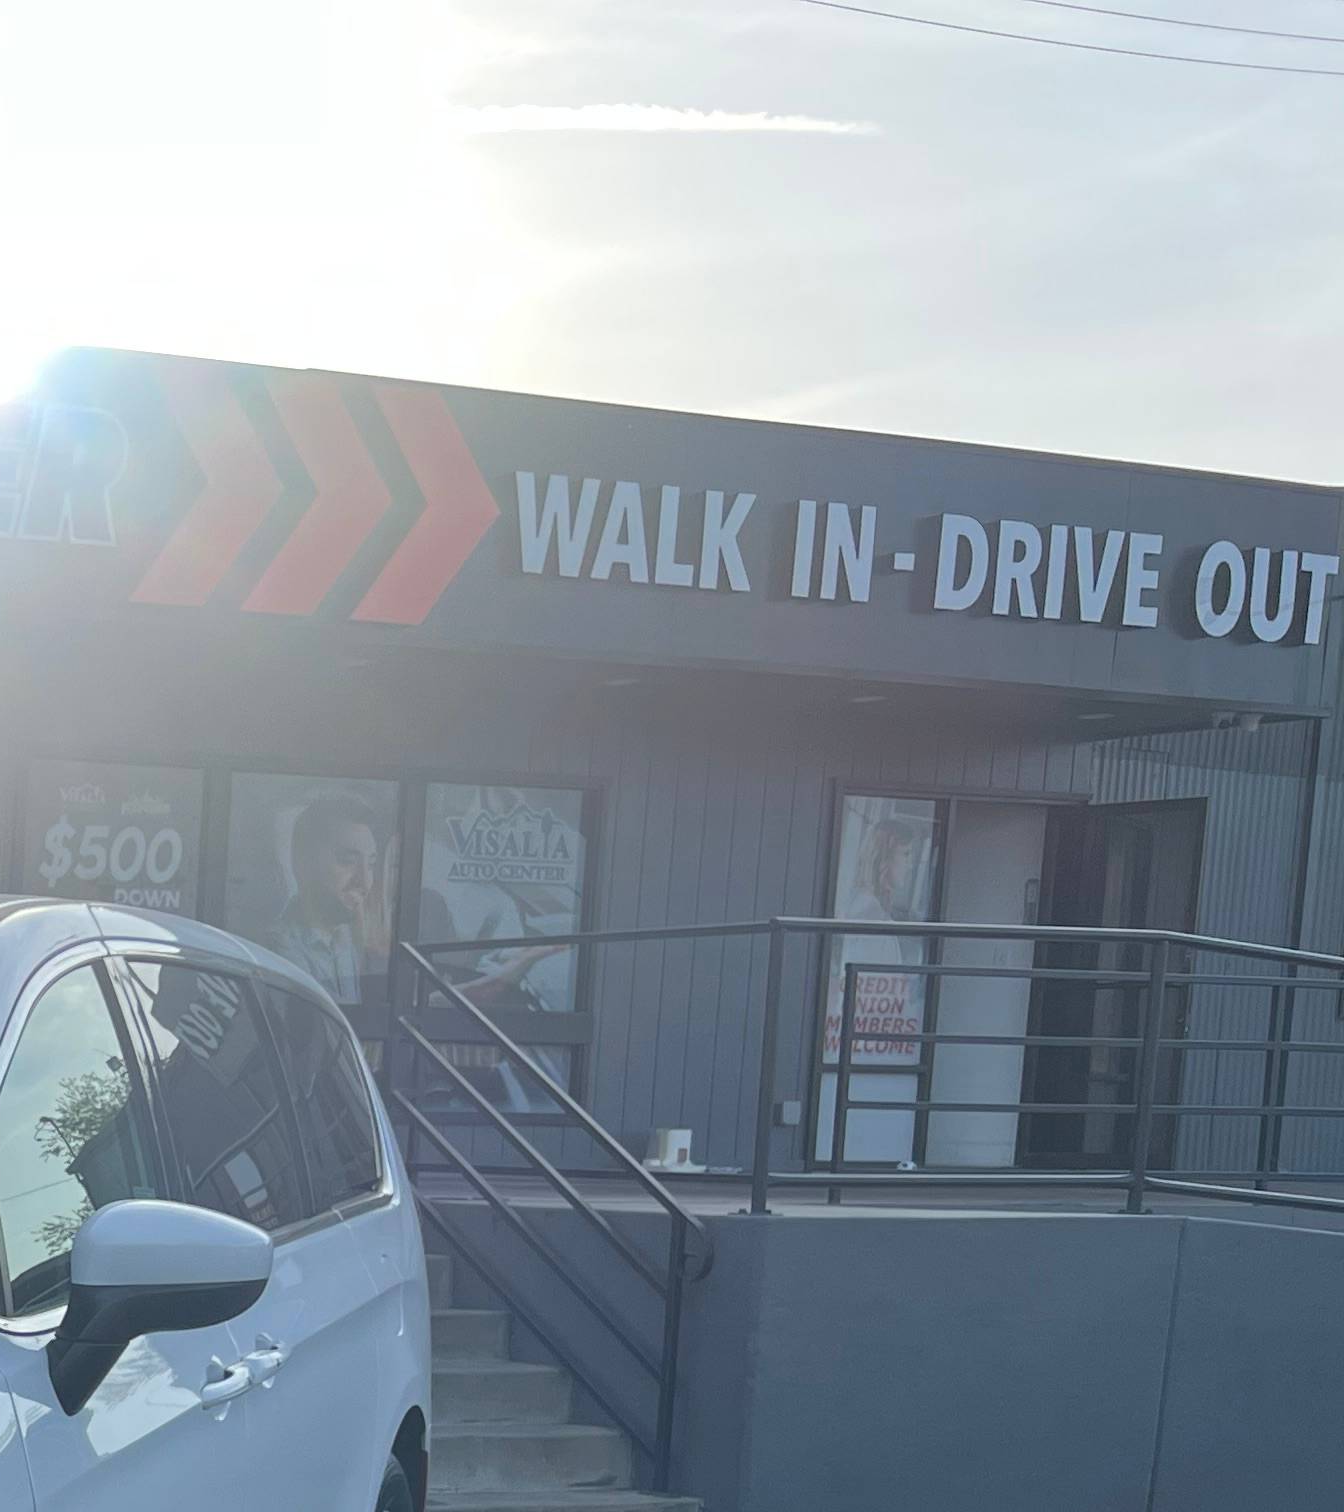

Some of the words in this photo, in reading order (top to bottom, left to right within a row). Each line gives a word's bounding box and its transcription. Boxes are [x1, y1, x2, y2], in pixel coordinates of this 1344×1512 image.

[515, 470, 757, 592] WALK
[1196, 539, 1340, 645] OUT
[445, 801, 574, 860] VISALIA
[38, 815, 183, 888] $500
[448, 862, 496, 880] AUTO
[498, 865, 567, 883] CENTER
[115, 888, 181, 908] DOWN
[825, 1016, 917, 1034] MMBERS
[824, 1035, 916, 1054] WLCOME
